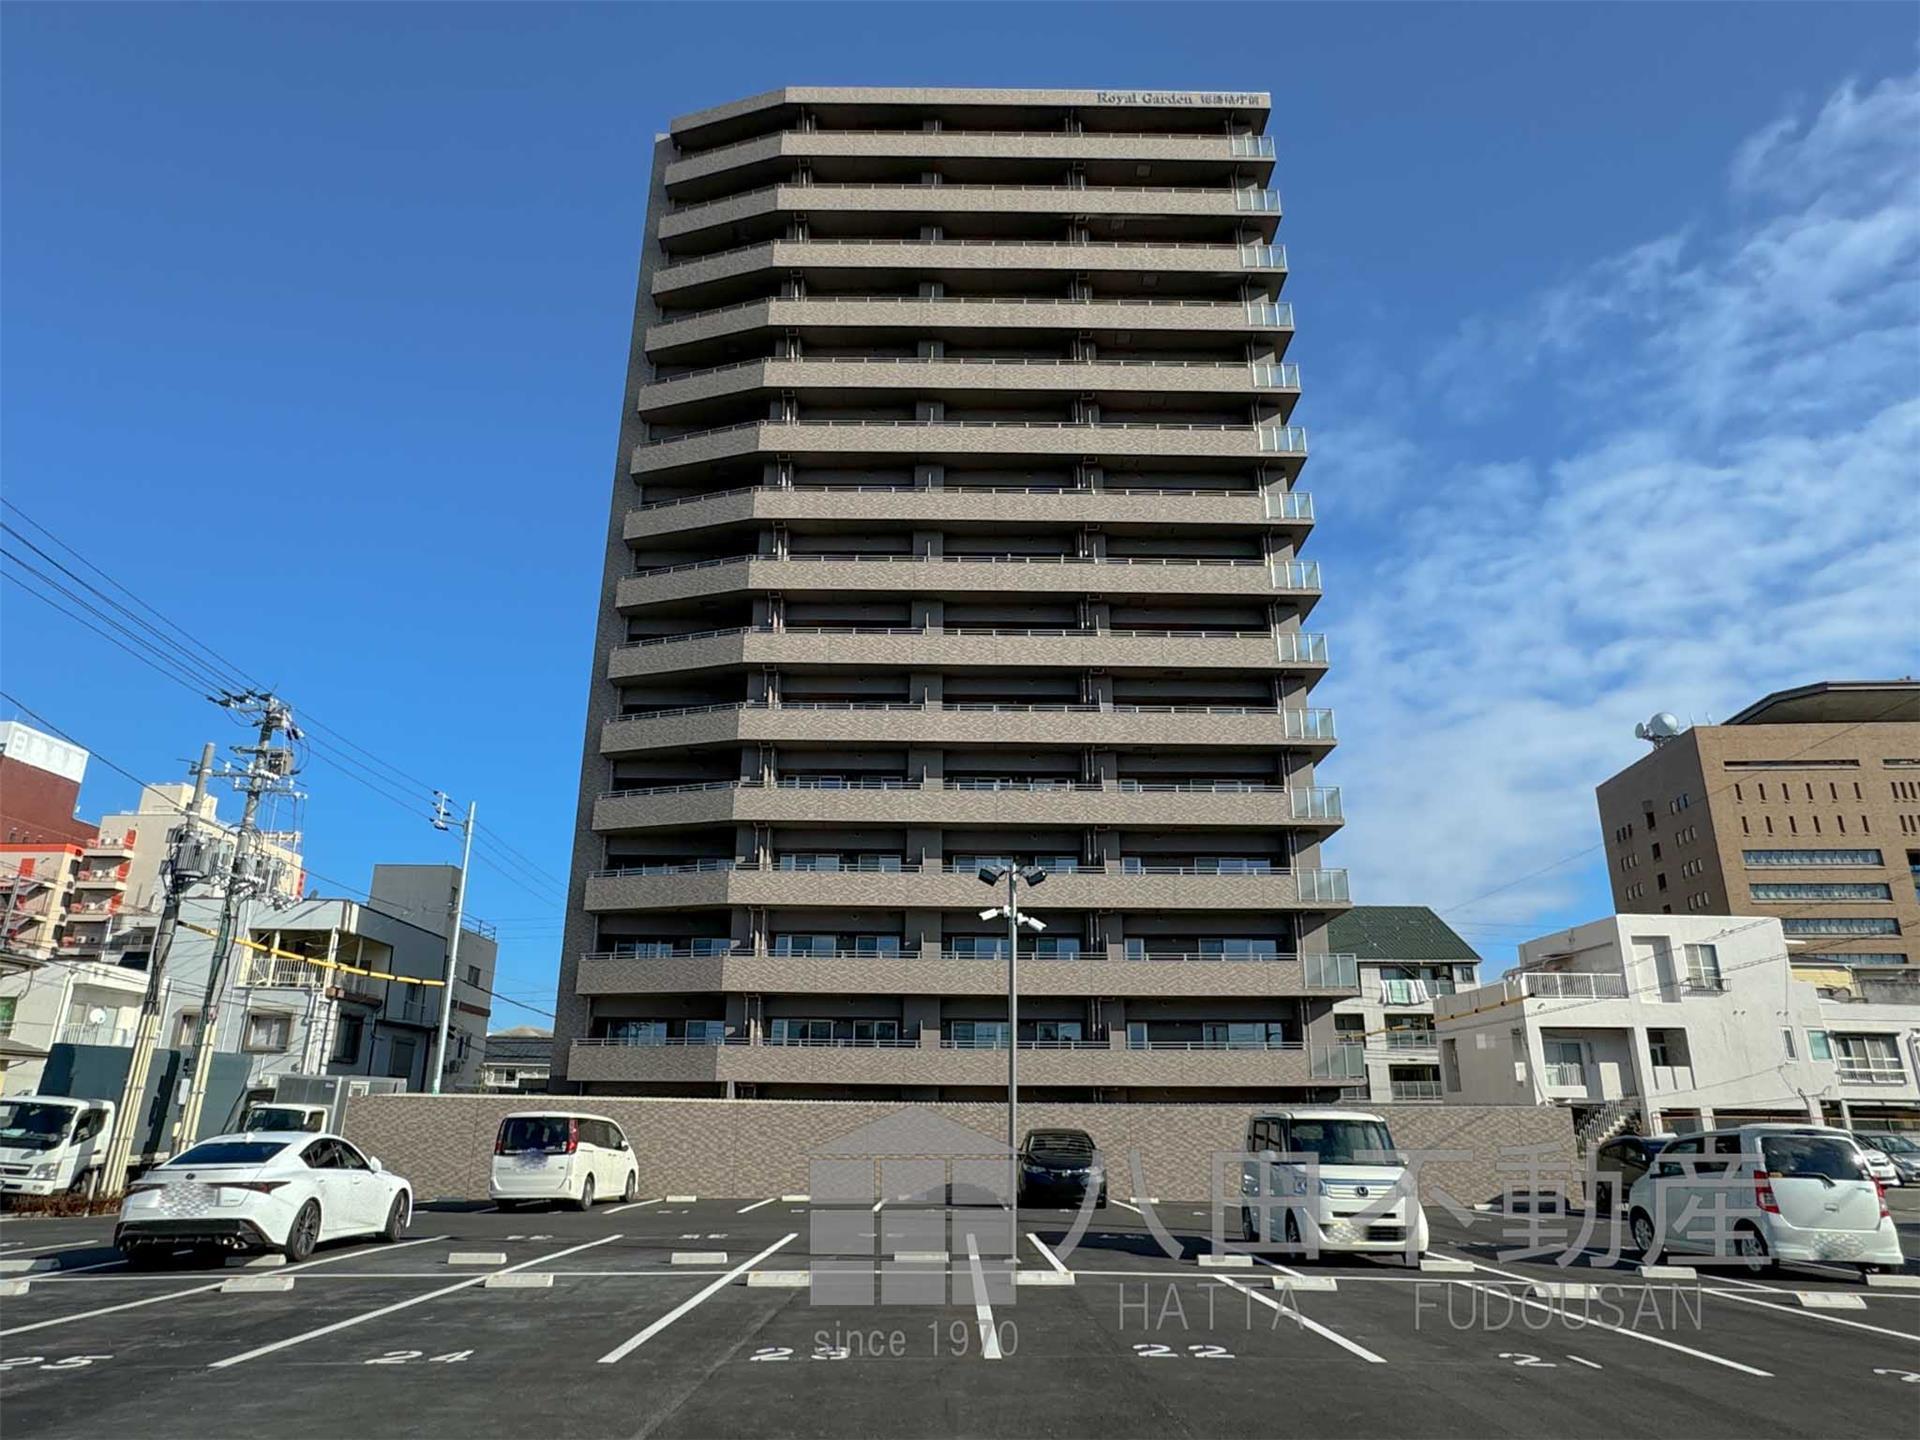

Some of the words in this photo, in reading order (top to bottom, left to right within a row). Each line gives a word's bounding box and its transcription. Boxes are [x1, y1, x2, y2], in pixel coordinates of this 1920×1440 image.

[1097, 92, 1137, 105] Royal
[1142, 93, 1193, 105] Garden
[364, 1350, 475, 1365] 24
[1133, 1344, 1236, 1359] 22
